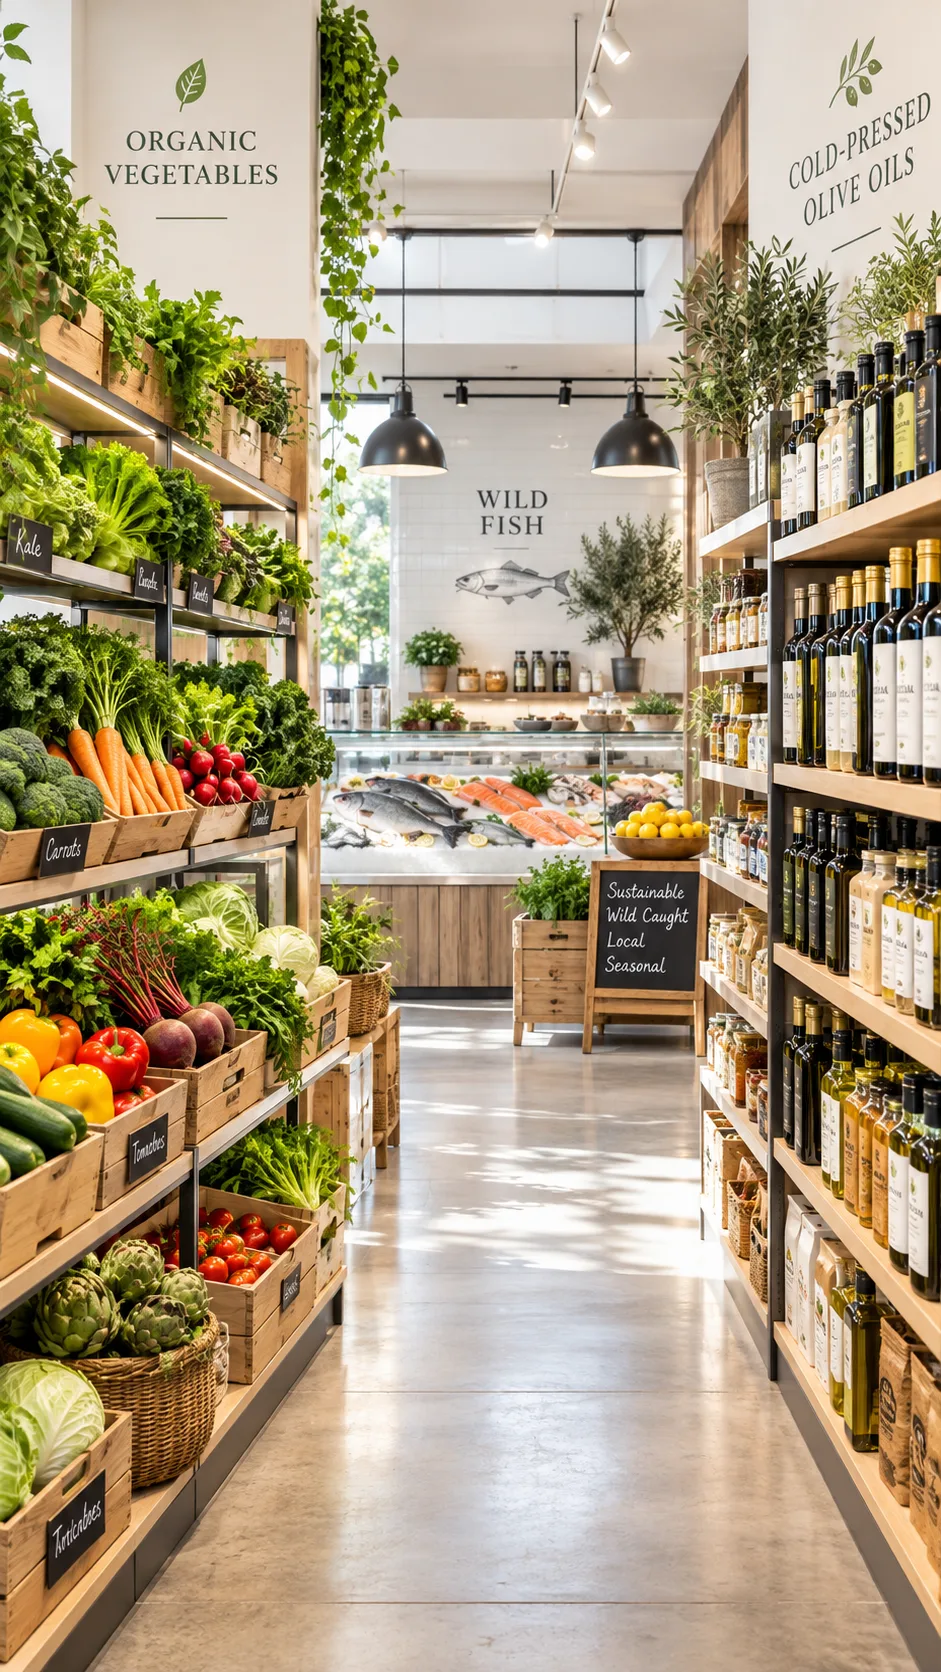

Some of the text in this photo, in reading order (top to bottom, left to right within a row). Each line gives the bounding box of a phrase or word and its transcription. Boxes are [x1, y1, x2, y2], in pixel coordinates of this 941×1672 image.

[126, 130, 257, 152] ORGANIC
[789, 92, 931, 190] COLD-PRESSED
[104, 164, 279, 185] VEGETABLES
[804, 146, 914, 226] OLIVE OILS
[476, 489, 548, 509] WILD
[480, 515, 544, 535] FISH
[16, 527, 42, 558] Kale
[45, 837, 82, 862] Carrots
[607, 881, 685, 899] Sustainable
[606, 906, 689, 931] Wild Caught
[607, 931, 646, 948] Local
[604, 955, 667, 973] Seasonal
